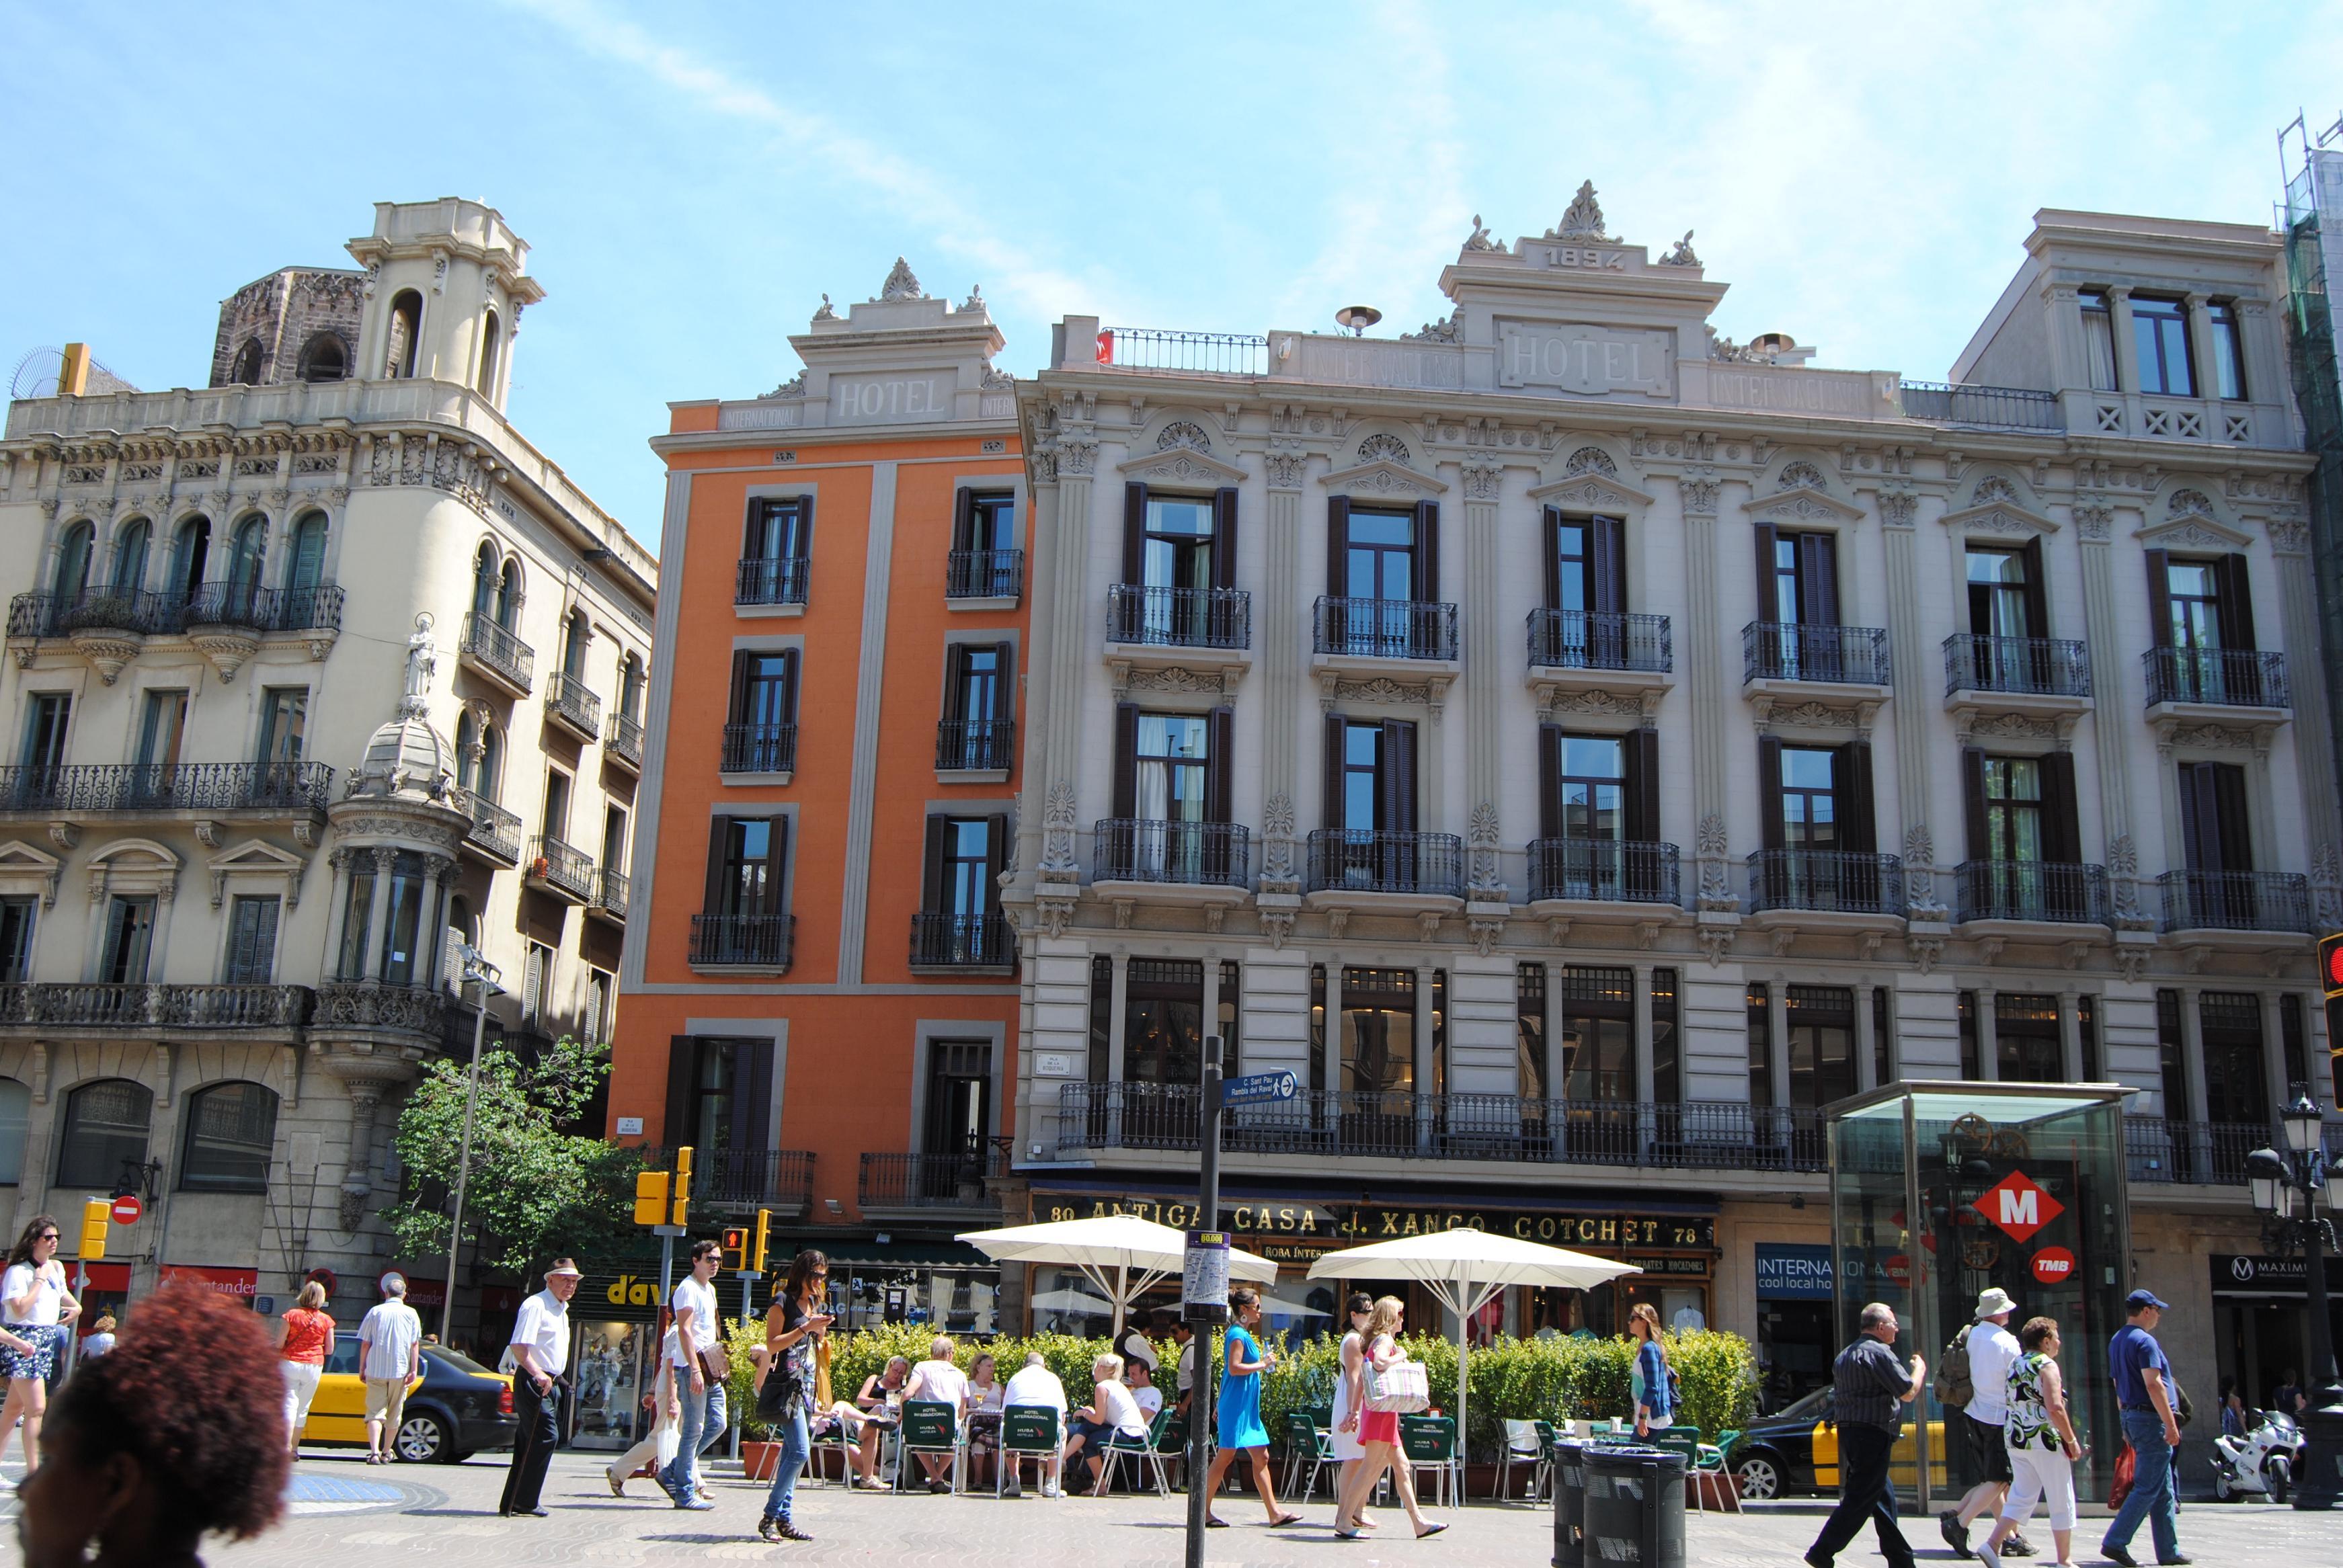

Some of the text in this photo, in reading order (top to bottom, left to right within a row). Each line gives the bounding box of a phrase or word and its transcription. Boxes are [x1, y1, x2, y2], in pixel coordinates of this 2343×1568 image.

[1546, 247, 1625, 270] 1894
[1513, 335, 1655, 383] HOTEL
[838, 379, 946, 417] HOTEL
[725, 407, 797, 428] INTERNACIONAL
[1250, 1077, 1262, 1085] Sant
[1231, 1087, 1248, 1096] Rambla
[1259, 1084, 1273, 1093] Raval
[1999, 1190, 2038, 1224] M
[1051, 1206, 1075, 1221] 80
[1234, 1206, 1316, 1231] CASA
[1514, 1216, 1658, 1242] COTCHET
[1674, 1228, 1696, 1243] 78
[1201, 1233, 1223, 1243] 80.000
[1265, 1246, 1291, 1258] ROBA
[2036, 1260, 2069, 1272] TMB
[1759, 1277, 1784, 1288] cool
[1786, 1277, 1814, 1289] local
[406, 1288, 442, 1305] Santander
[819, 1303, 846, 1314] D&G
